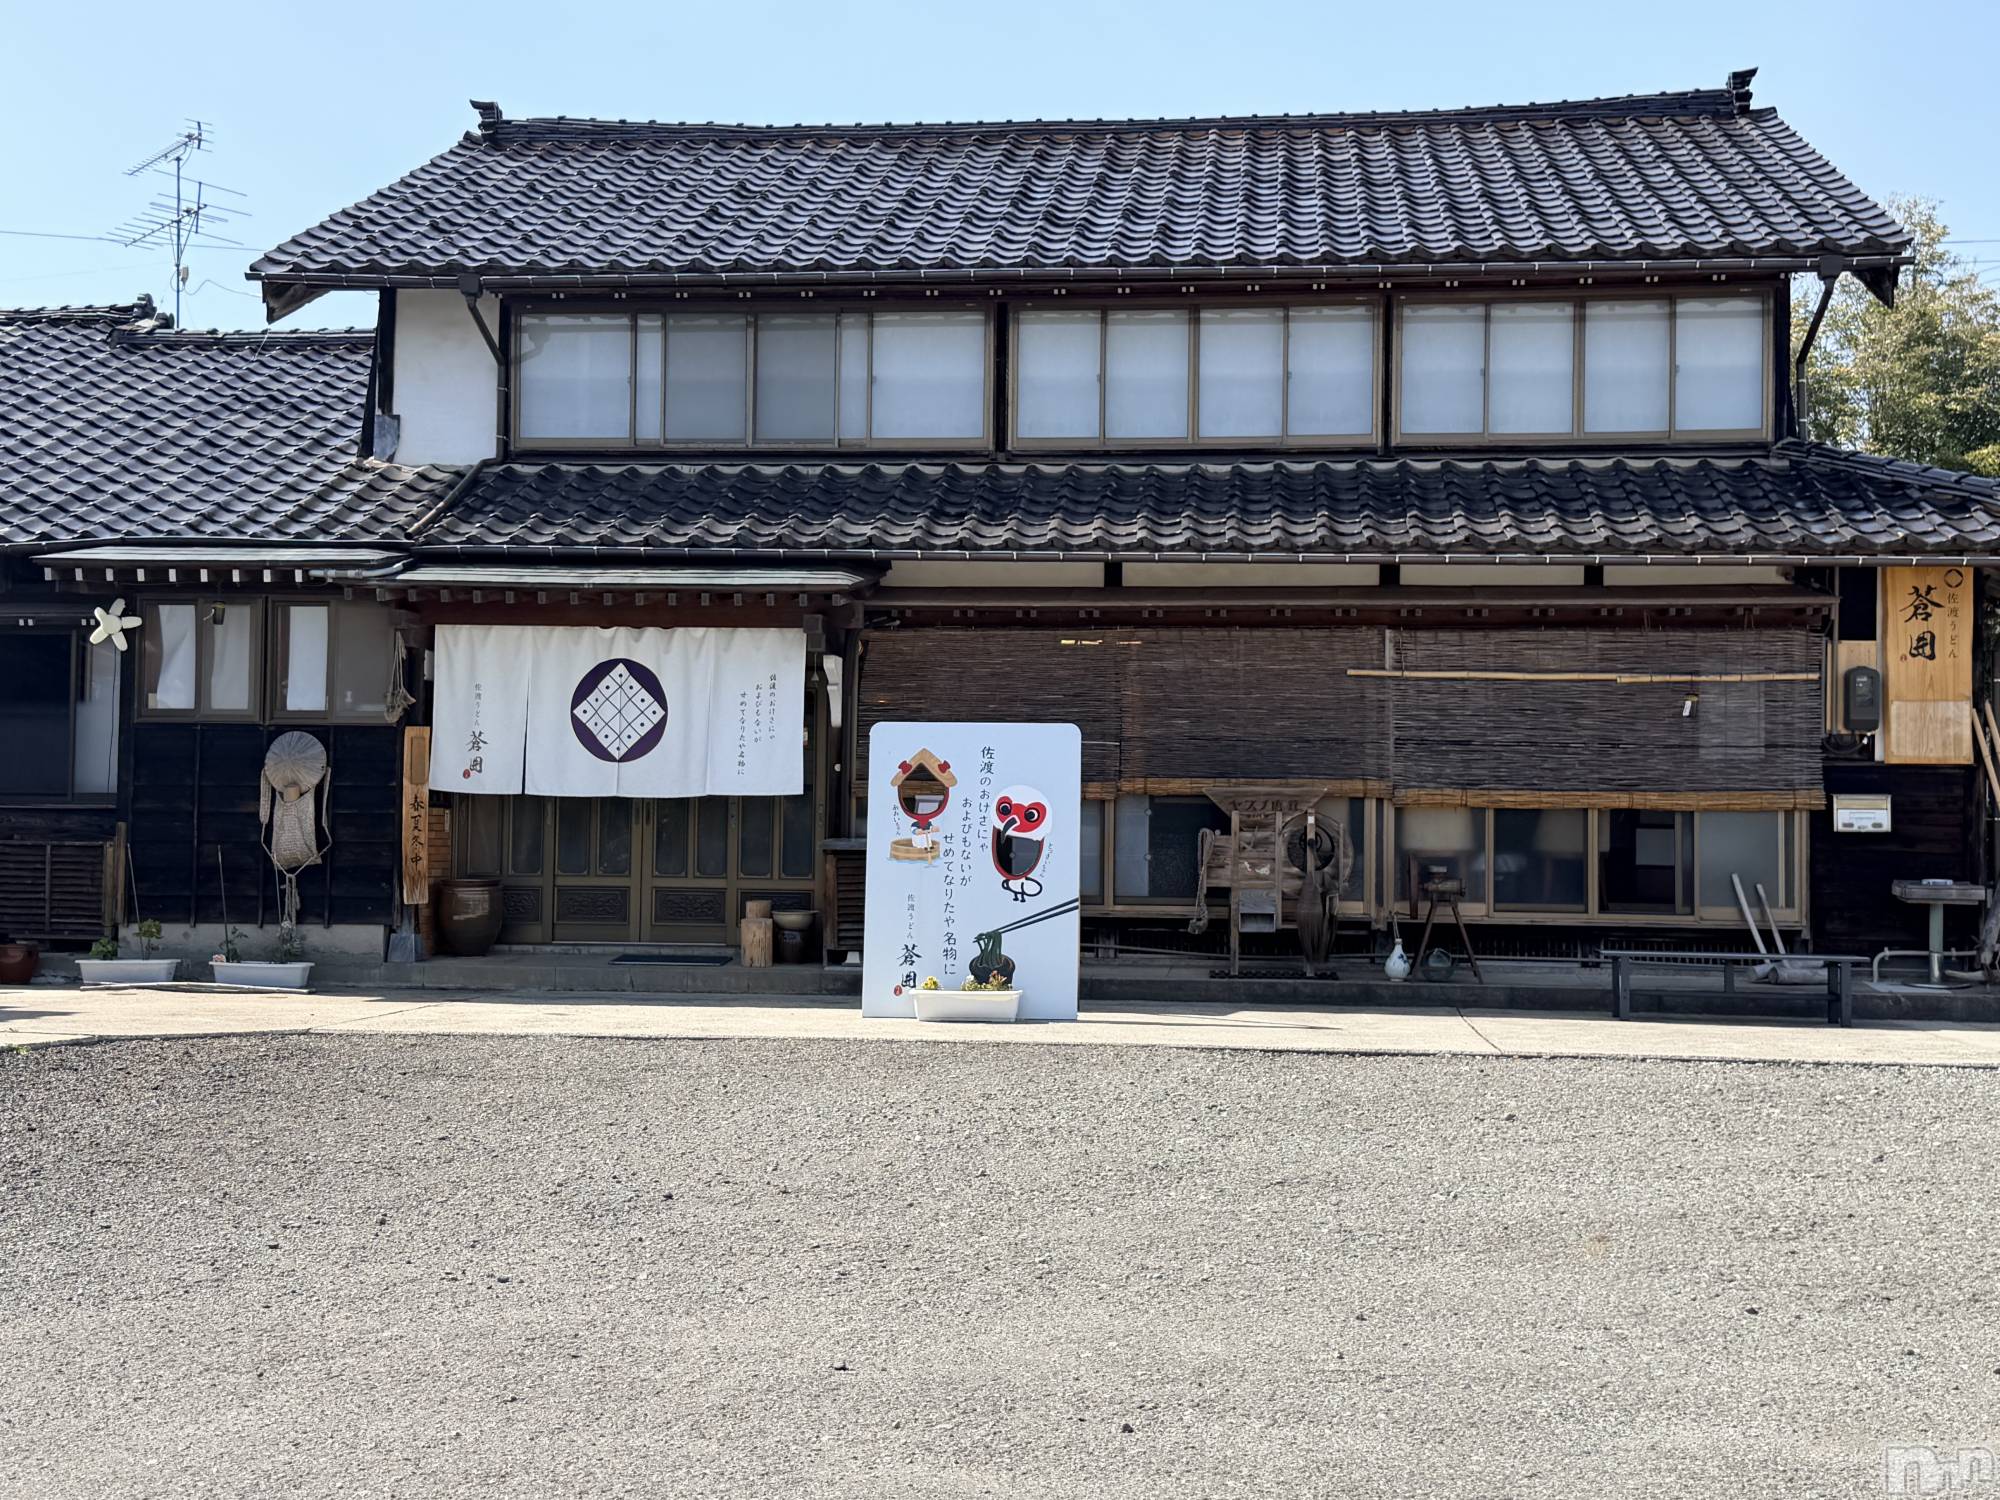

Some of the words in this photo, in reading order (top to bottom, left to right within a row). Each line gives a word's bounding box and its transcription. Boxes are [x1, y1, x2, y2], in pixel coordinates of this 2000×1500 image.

[1947, 592, 1960, 660] 佐渡うどん
[409, 794, 425, 872] 春夏冬中
[960, 796, 973, 887] およびもないが
[907, 893, 915, 940] 佐渡うどん
[942, 833, 957, 975] せめてなりたや名物に
